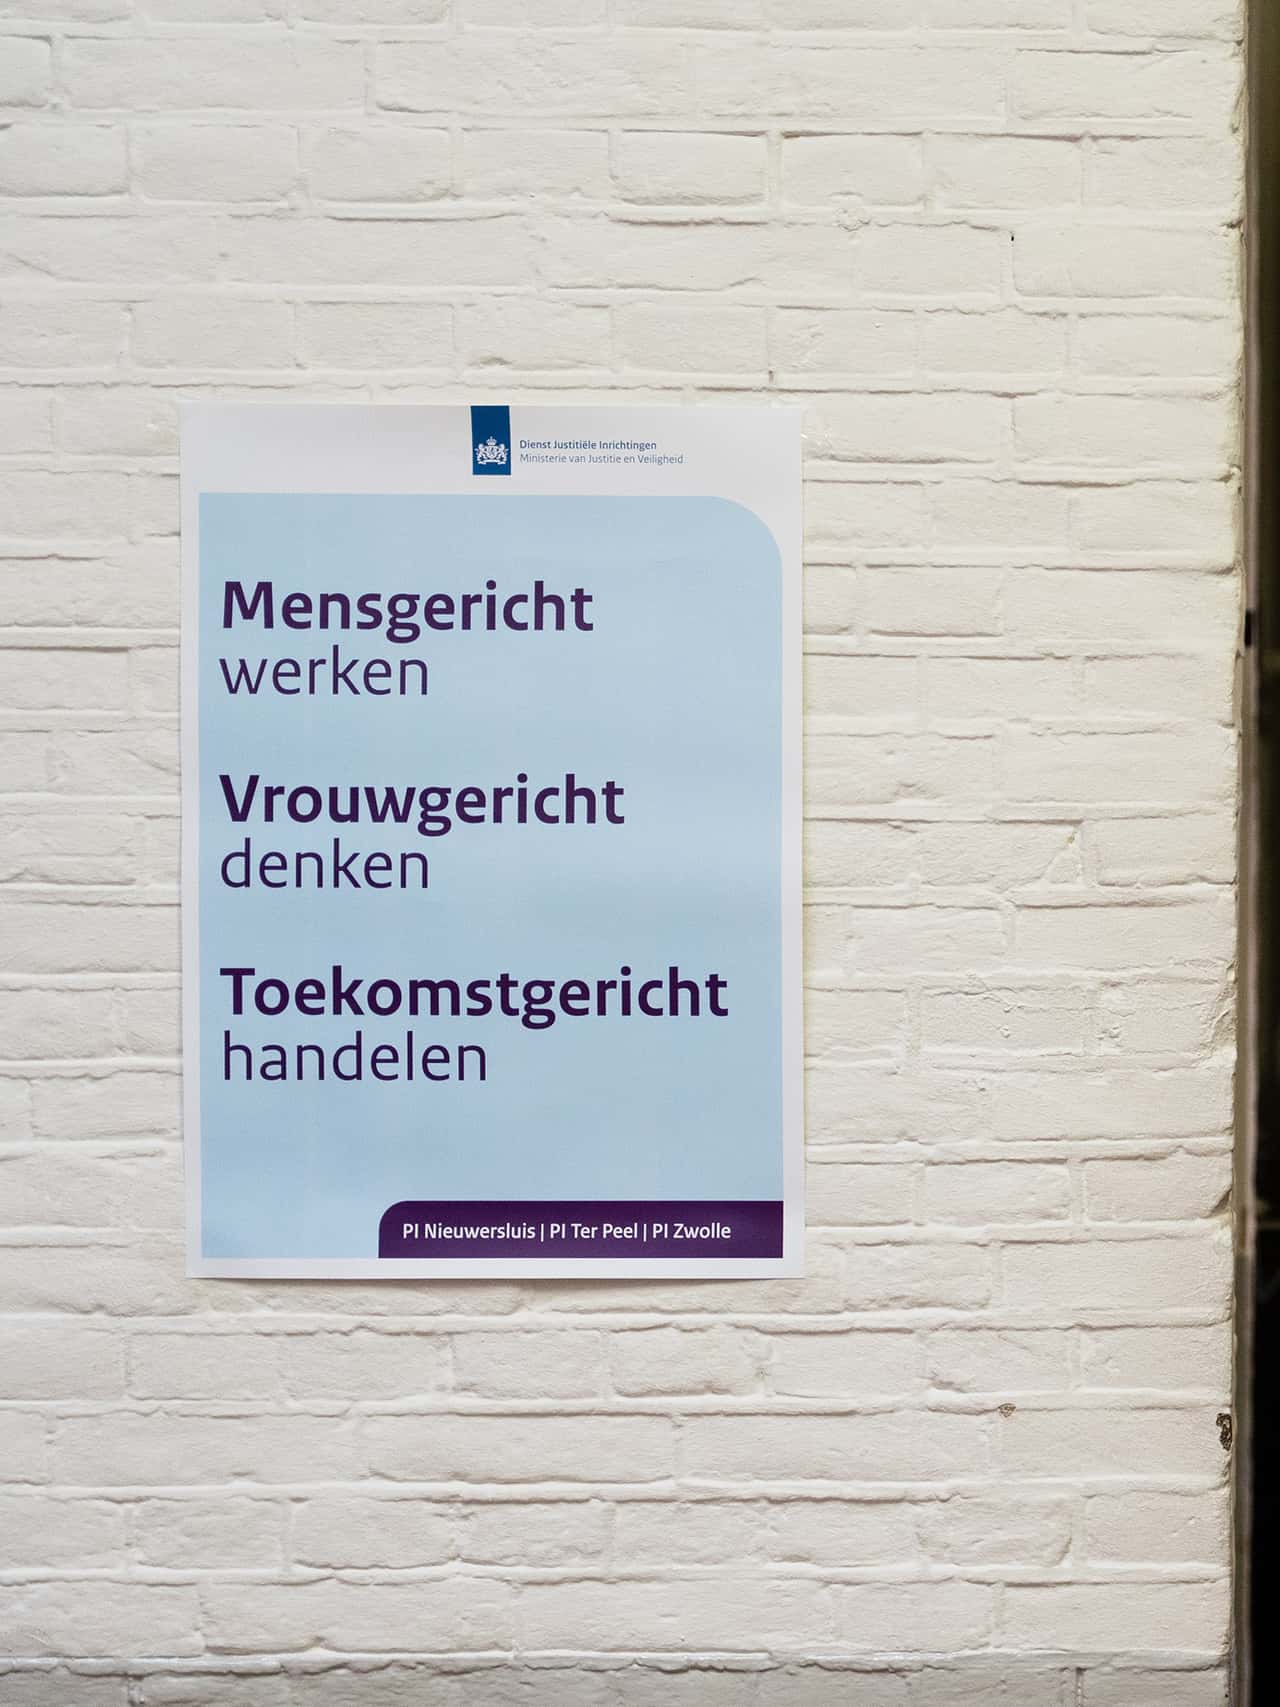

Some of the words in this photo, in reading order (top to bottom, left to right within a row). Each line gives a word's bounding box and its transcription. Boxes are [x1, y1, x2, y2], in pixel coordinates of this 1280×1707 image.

[519, 440, 551, 450] Dienst
[553, 440, 597, 450] Justitiële
[599, 440, 657, 452] Inrichtingen
[519, 453, 567, 464] Ministerie
[568, 455, 586, 464] van
[588, 454, 622, 464] Justitie
[624, 456, 636, 464] en
[637, 453, 684, 466] Veiligheid
[222, 580, 594, 644] Mensgericht
[219, 646, 429, 696] werken
[219, 773, 625, 836] Vrouwgericht
[219, 838, 430, 889] denken
[219, 965, 729, 1030] Toekomstgericht
[222, 1029, 487, 1082] handelen
[403, 1223, 419, 1239] PI
[424, 1222, 536, 1239] Nieuwersluis
[550, 1223, 566, 1239] PI
[571, 1223, 599, 1239] Ter
[602, 1222, 638, 1239] Peel
[652, 1223, 668, 1239] PI
[673, 1222, 731, 1239] Zwolle
